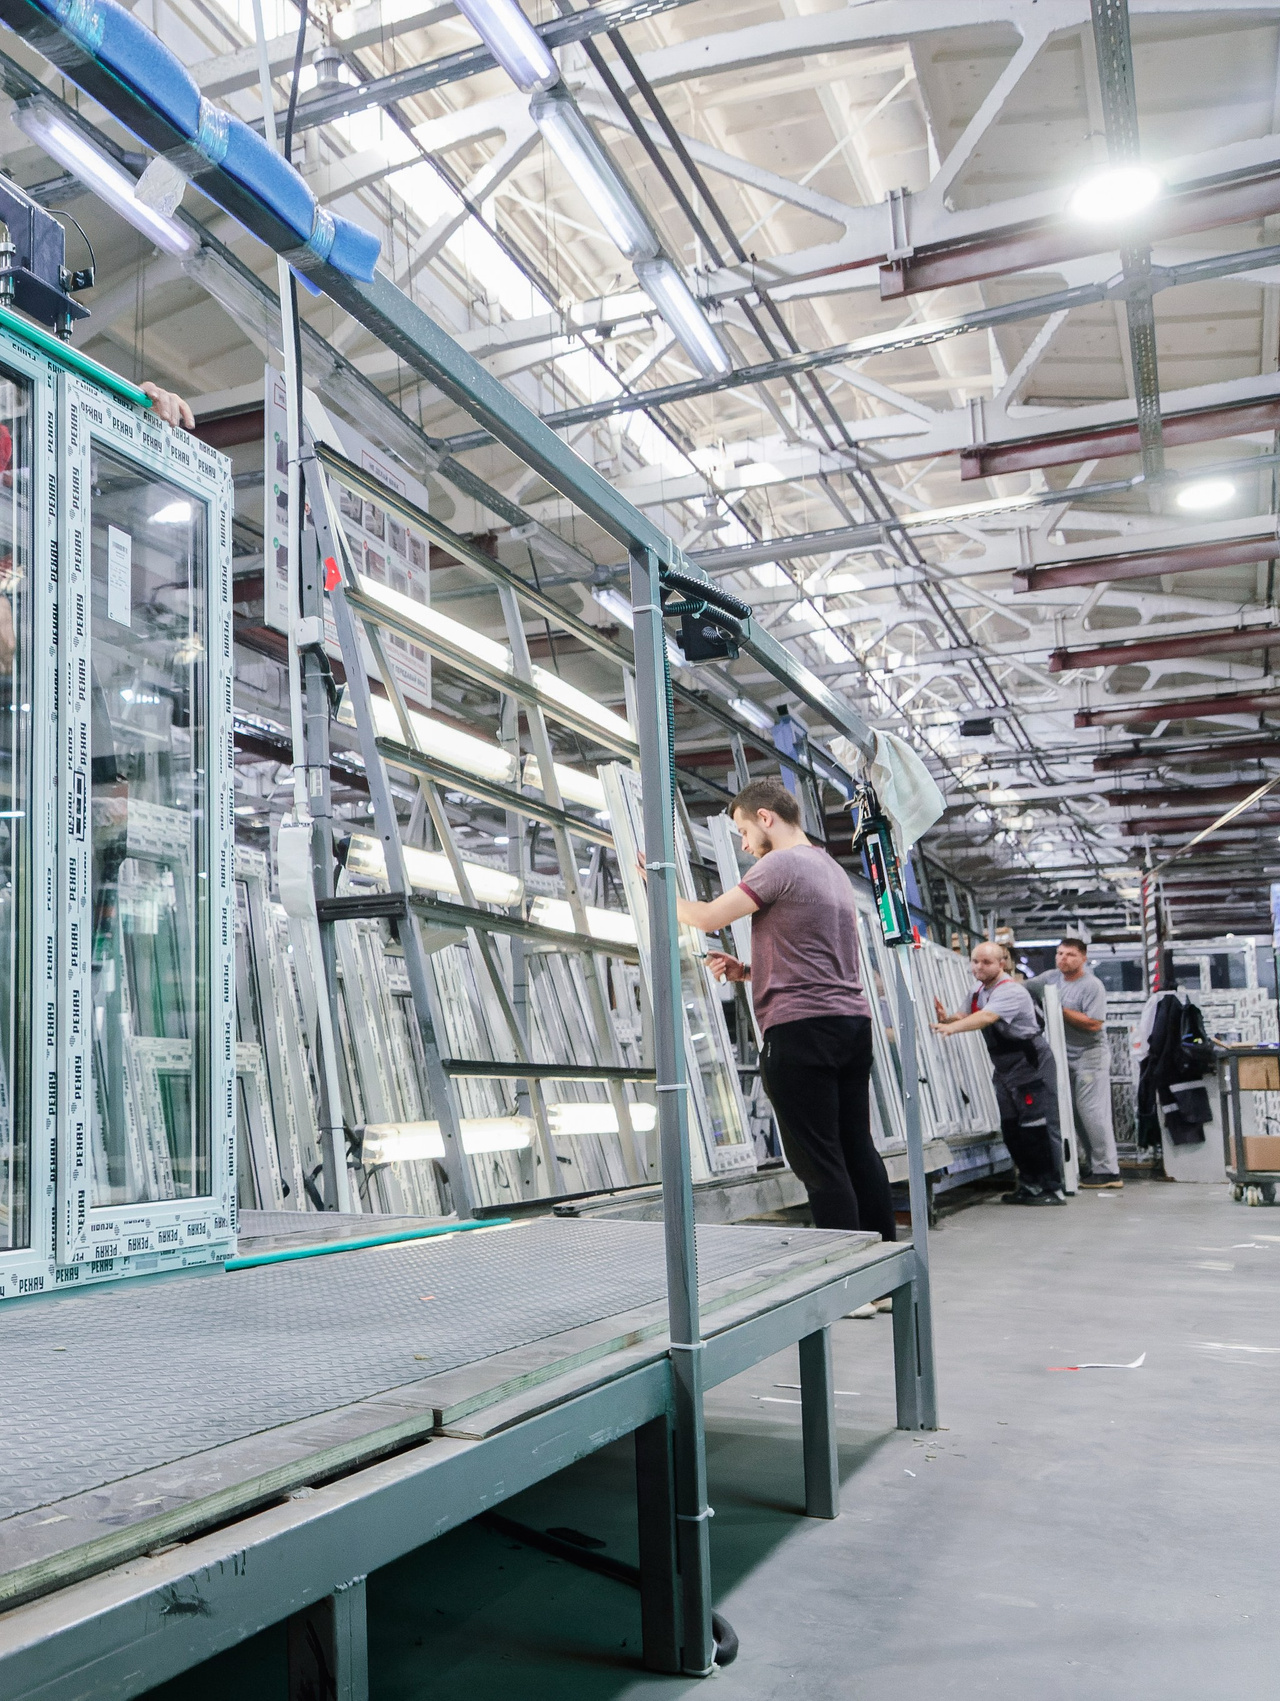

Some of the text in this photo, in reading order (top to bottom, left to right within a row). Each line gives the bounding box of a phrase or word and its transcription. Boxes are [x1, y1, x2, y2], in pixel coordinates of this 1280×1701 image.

[70, 403, 78, 446] РЕХАУ
[112, 416, 134, 438] РЕХАУ
[172, 426, 190, 445] РЕХАУ
[142, 432, 162, 454] РЕХАУ
[170, 445, 190, 466] РЕХАУ
[198, 458, 216, 479] РЕХАУ
[72, 466, 80, 510] РЕХАУ
[50, 539, 58, 583] РЕХАУ
[78, 658, 86, 702] РЕХАУ
[68, 857, 76, 902] РЕХАУ
[70, 922, 78, 967] РЕХАУ
[46, 1002, 54, 1047] РЕХАУ
[72, 990, 80, 1034] РЕХАУ
[48, 1070, 56, 1116] РЕХАУ
[74, 1055, 82, 1100] РЕХАУ
[76, 1122, 84, 1168] РЕХАУ
[128, 1236, 148, 1251] РЕХАУ
[158, 1228, 178, 1244] РЕХАУ
[186, 1222, 206, 1236] РЕХАУ
[96, 1244, 118, 1258] РЕХАУ
[18, 1276, 44, 1294] РЕХАУ
[56, 1266, 80, 1284] РЕХАУ
